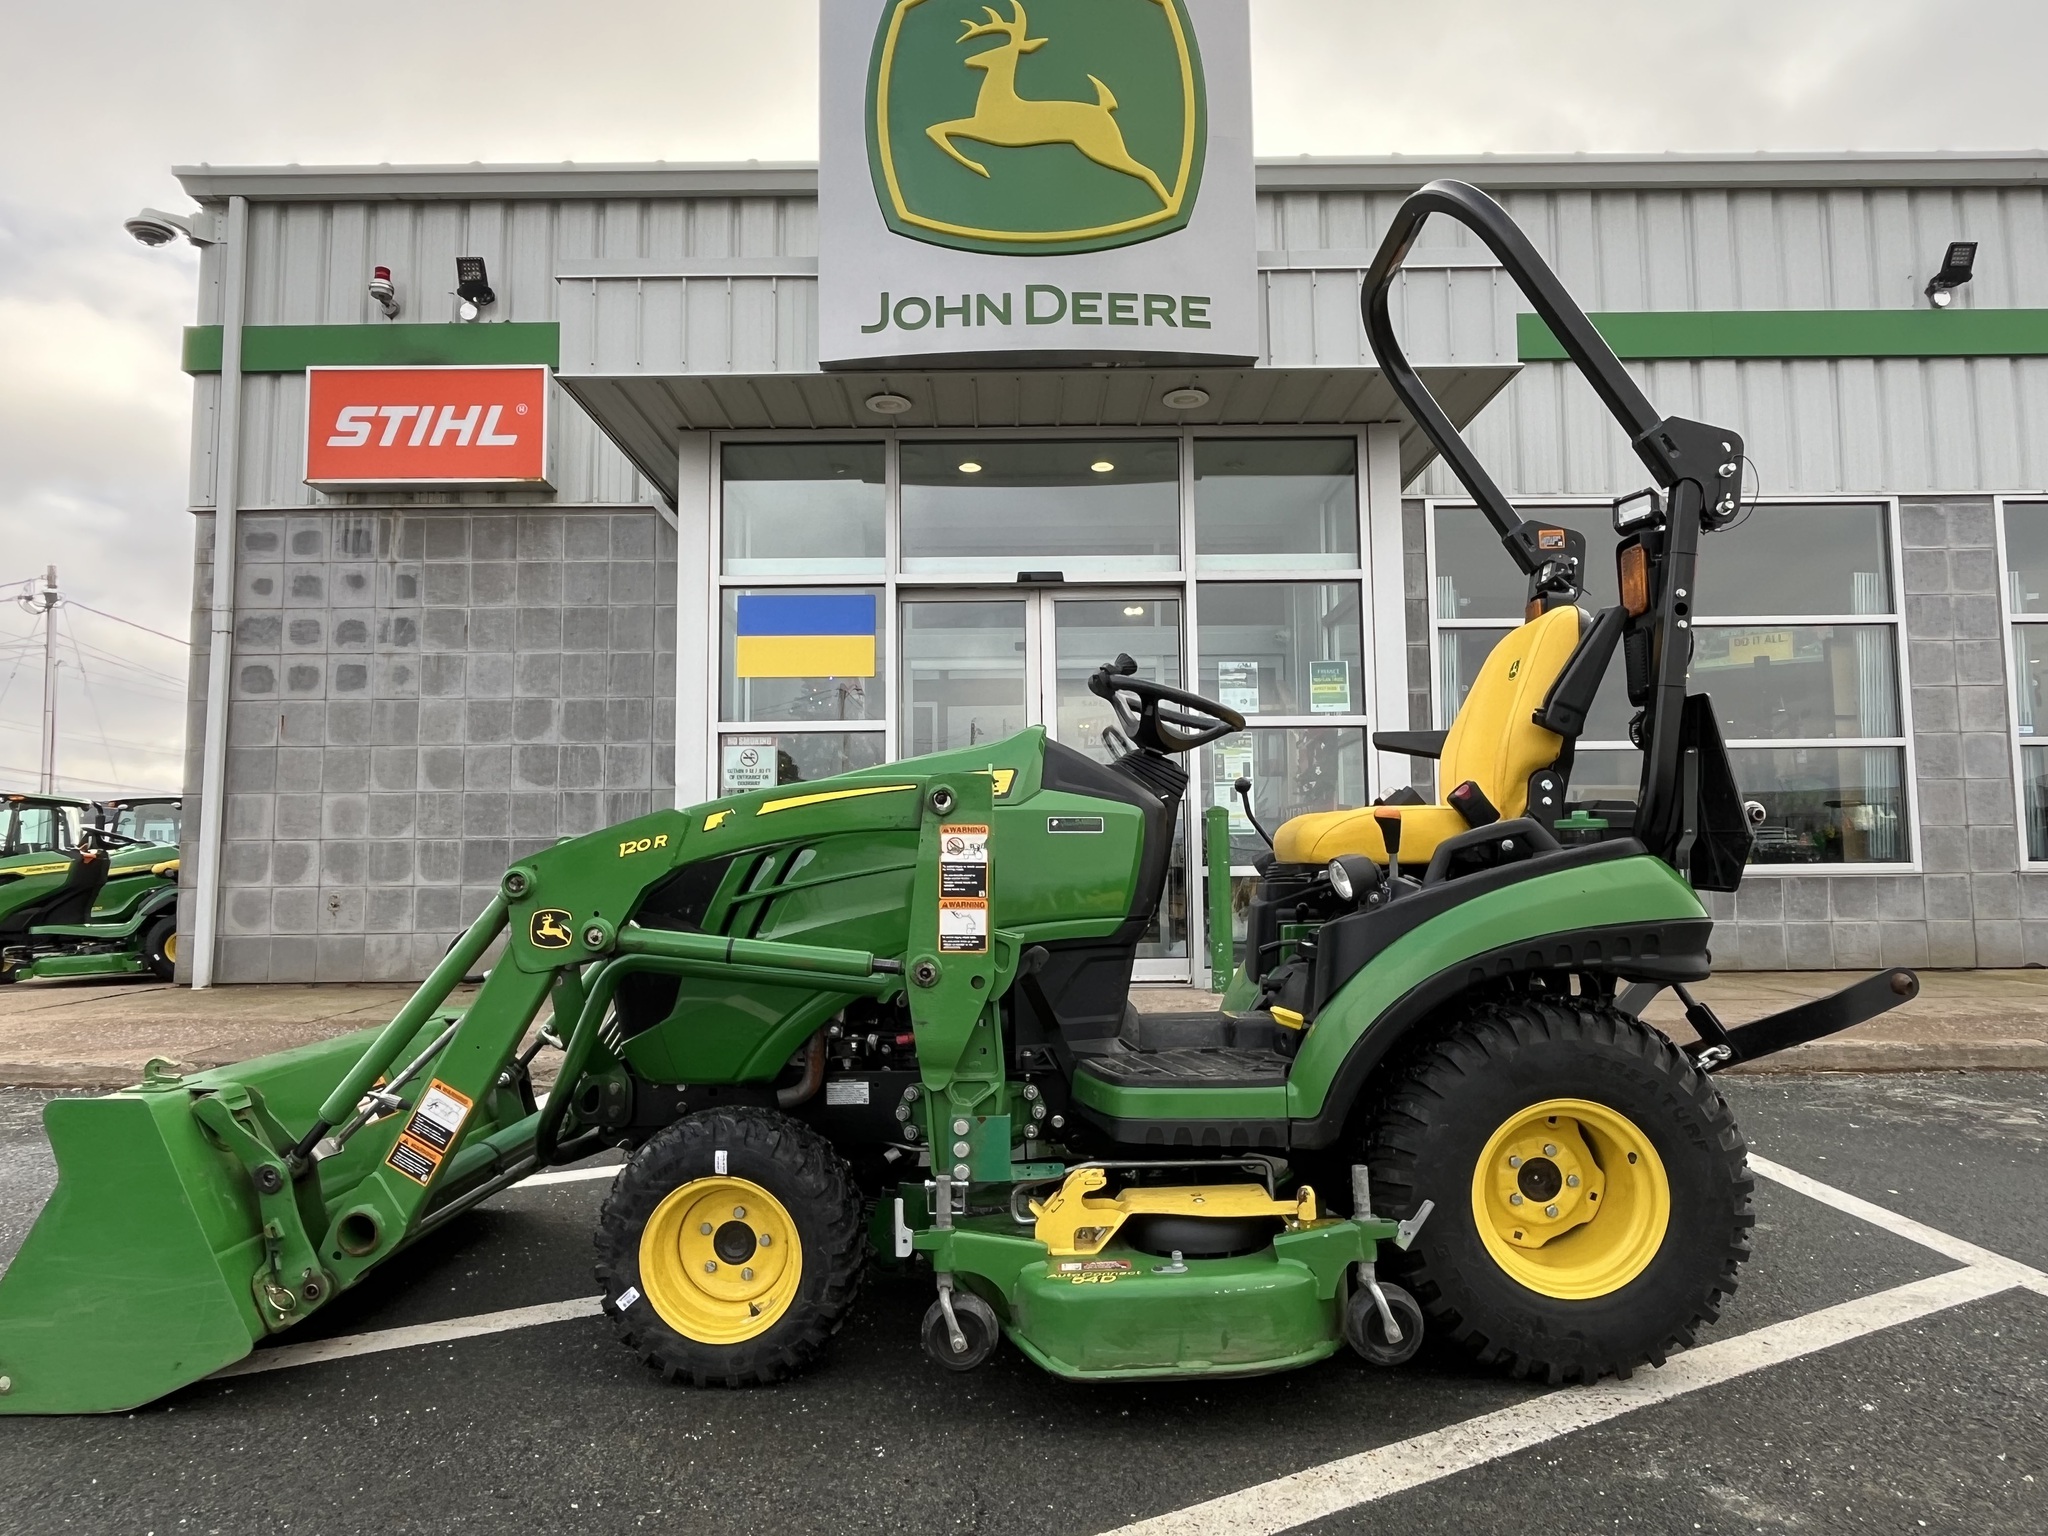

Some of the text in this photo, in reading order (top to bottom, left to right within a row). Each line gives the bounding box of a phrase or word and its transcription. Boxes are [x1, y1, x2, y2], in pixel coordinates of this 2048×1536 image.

[861, 284, 1212, 334] JOHN DEERE
[326, 404, 518, 447] STIHL
[1764, 633, 1787, 645] ALL
[738, 736, 772, 746] SMOKING
[619, 834, 668, 858] 120 R
[948, 901, 986, 909] WARNING
